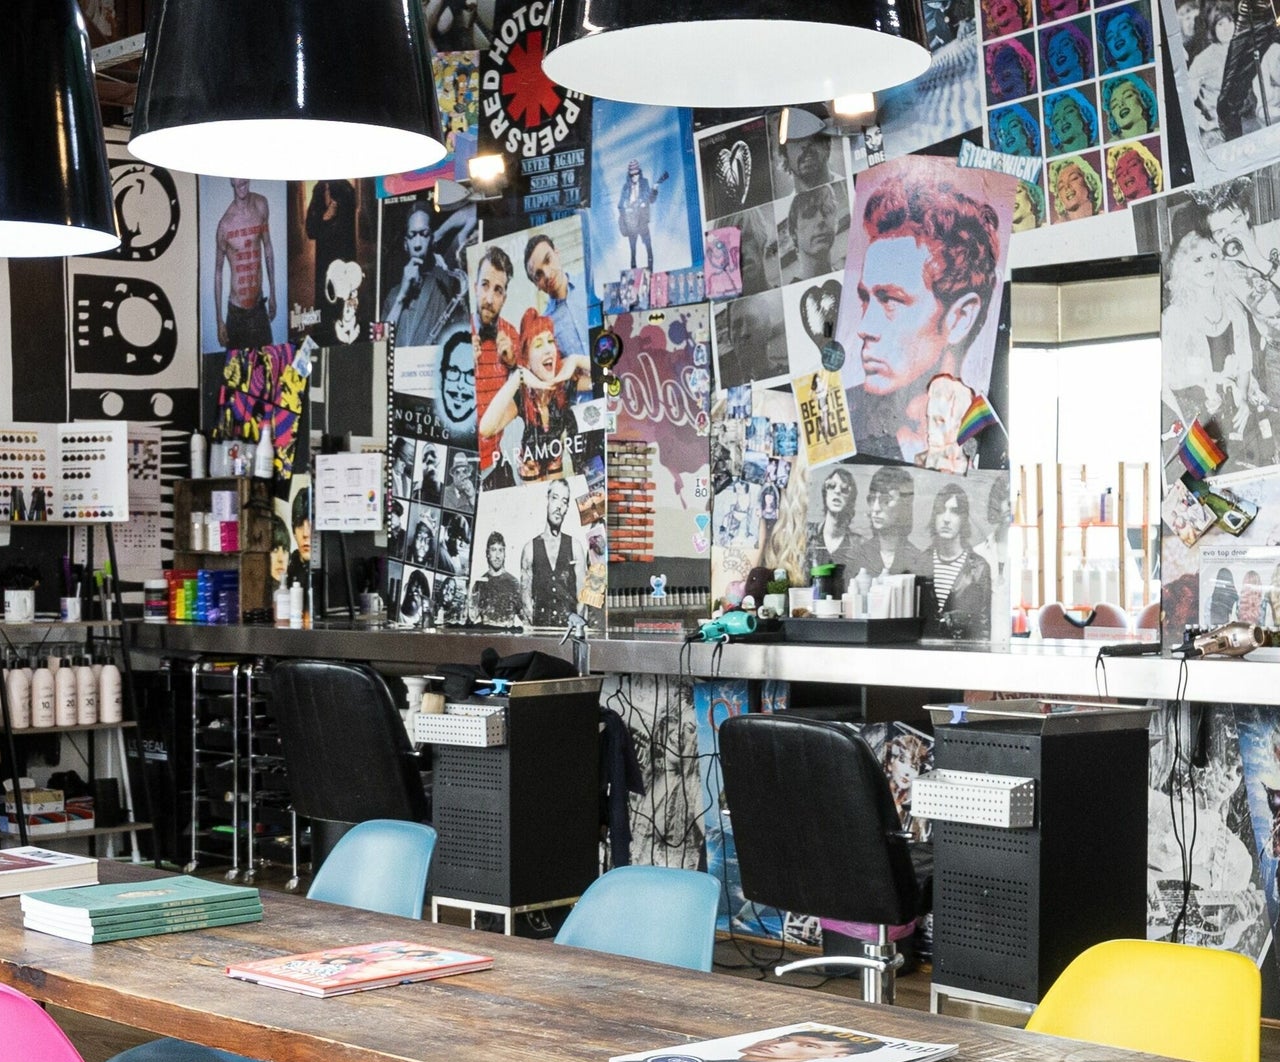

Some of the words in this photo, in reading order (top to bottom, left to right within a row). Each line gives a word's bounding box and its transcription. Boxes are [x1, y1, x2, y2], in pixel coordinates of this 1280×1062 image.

[489, 6, 527, 65] HOT
[483, 70, 510, 139] RED
[492, 435, 583, 468] PARAMORE
